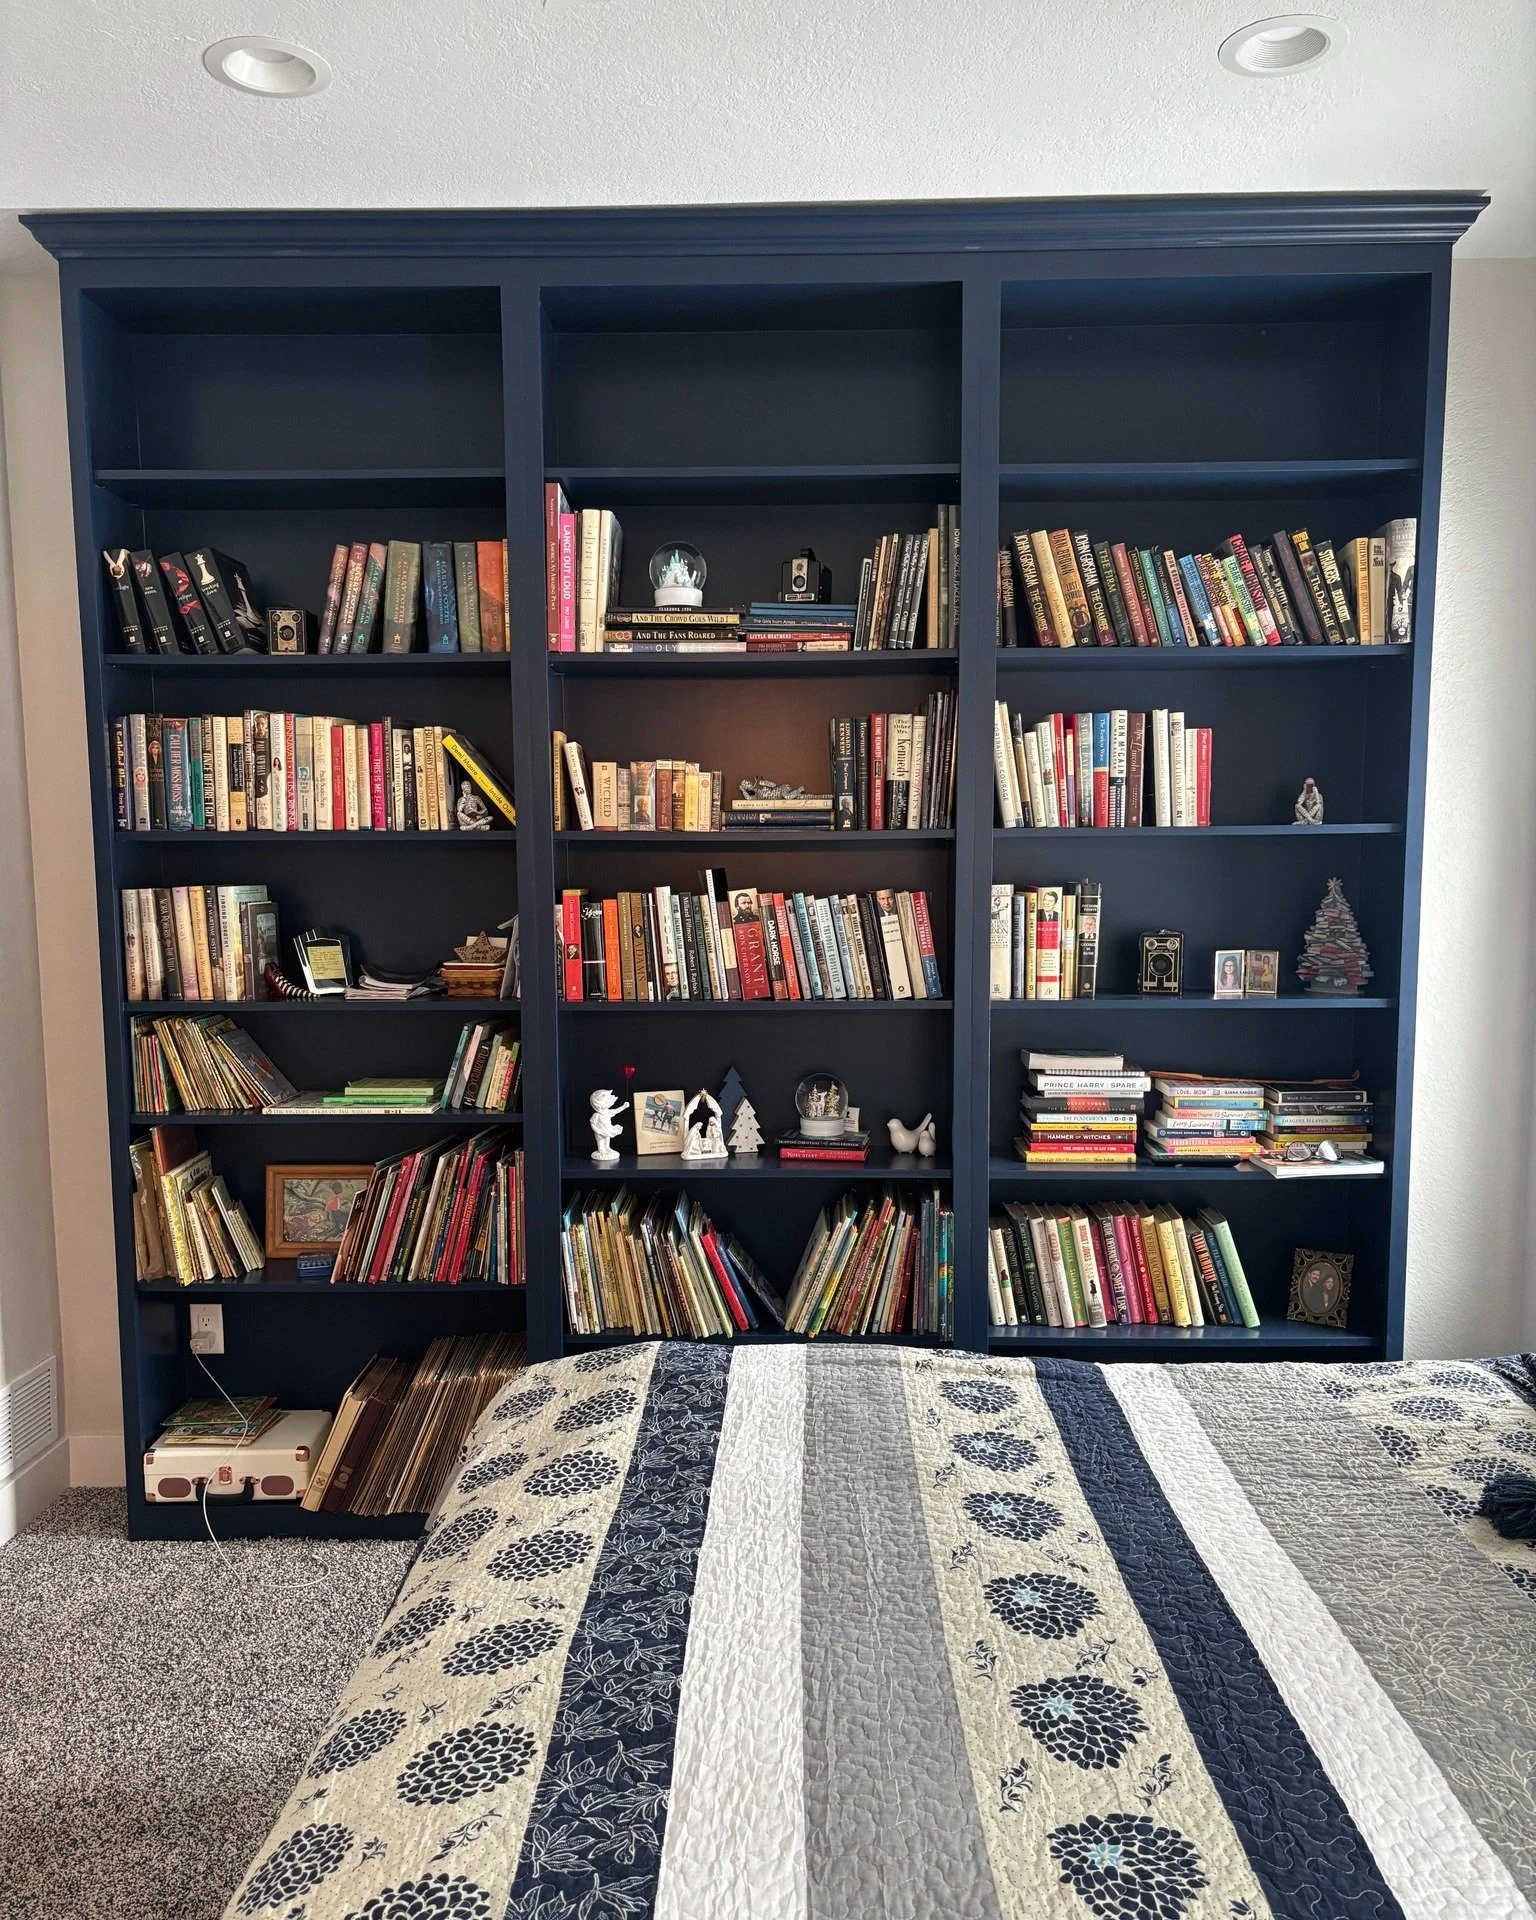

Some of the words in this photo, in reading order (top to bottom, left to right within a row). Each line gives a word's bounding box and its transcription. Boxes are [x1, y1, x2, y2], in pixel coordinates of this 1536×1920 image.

[563, 525, 571, 553] LANCE
[1014, 534, 1032, 554] JOHN
[1053, 534, 1066, 549] DAN
[1074, 534, 1092, 555] JOHN
[563, 556, 571, 573] OUT
[1057, 549, 1074, 576] BROWN
[1099, 548, 1110, 569] THE
[1020, 554, 1038, 587] GRISHAM
[1080, 554, 1099, 587] GRISHAM
[1104, 570, 1116, 593] FIRM
[1231, 538, 1250, 567] CRAIG
[1241, 566, 1267, 612] JOHNSON
[563, 576, 571, 600] LOUD
[1091, 588, 1100, 602] THE
[1228, 562, 1239, 583] CRAIG
[1235, 583, 1252, 615] JOHNSON
[1311, 575, 1320, 592] The
[1030, 589, 1040, 602] THE
[1129, 599, 1136, 609] TO
[1315, 591, 1328, 610] Dark
[1034, 602, 1048, 632] CHAMBER
[1094, 602, 1108, 633] CHAMBER
[1322, 610, 1334, 627] Half
[669, 631, 686, 639] FANS
[896, 738, 910, 779] Kennedy
[451, 744, 465, 758] Demi
[488, 788, 503, 806] Inside
[375, 783, 381, 793] ME
[684, 918, 692, 943] Fillmore
[768, 920, 776, 940] DARK
[747, 928, 765, 984] GRANT
[771, 941, 781, 966] HORSE
